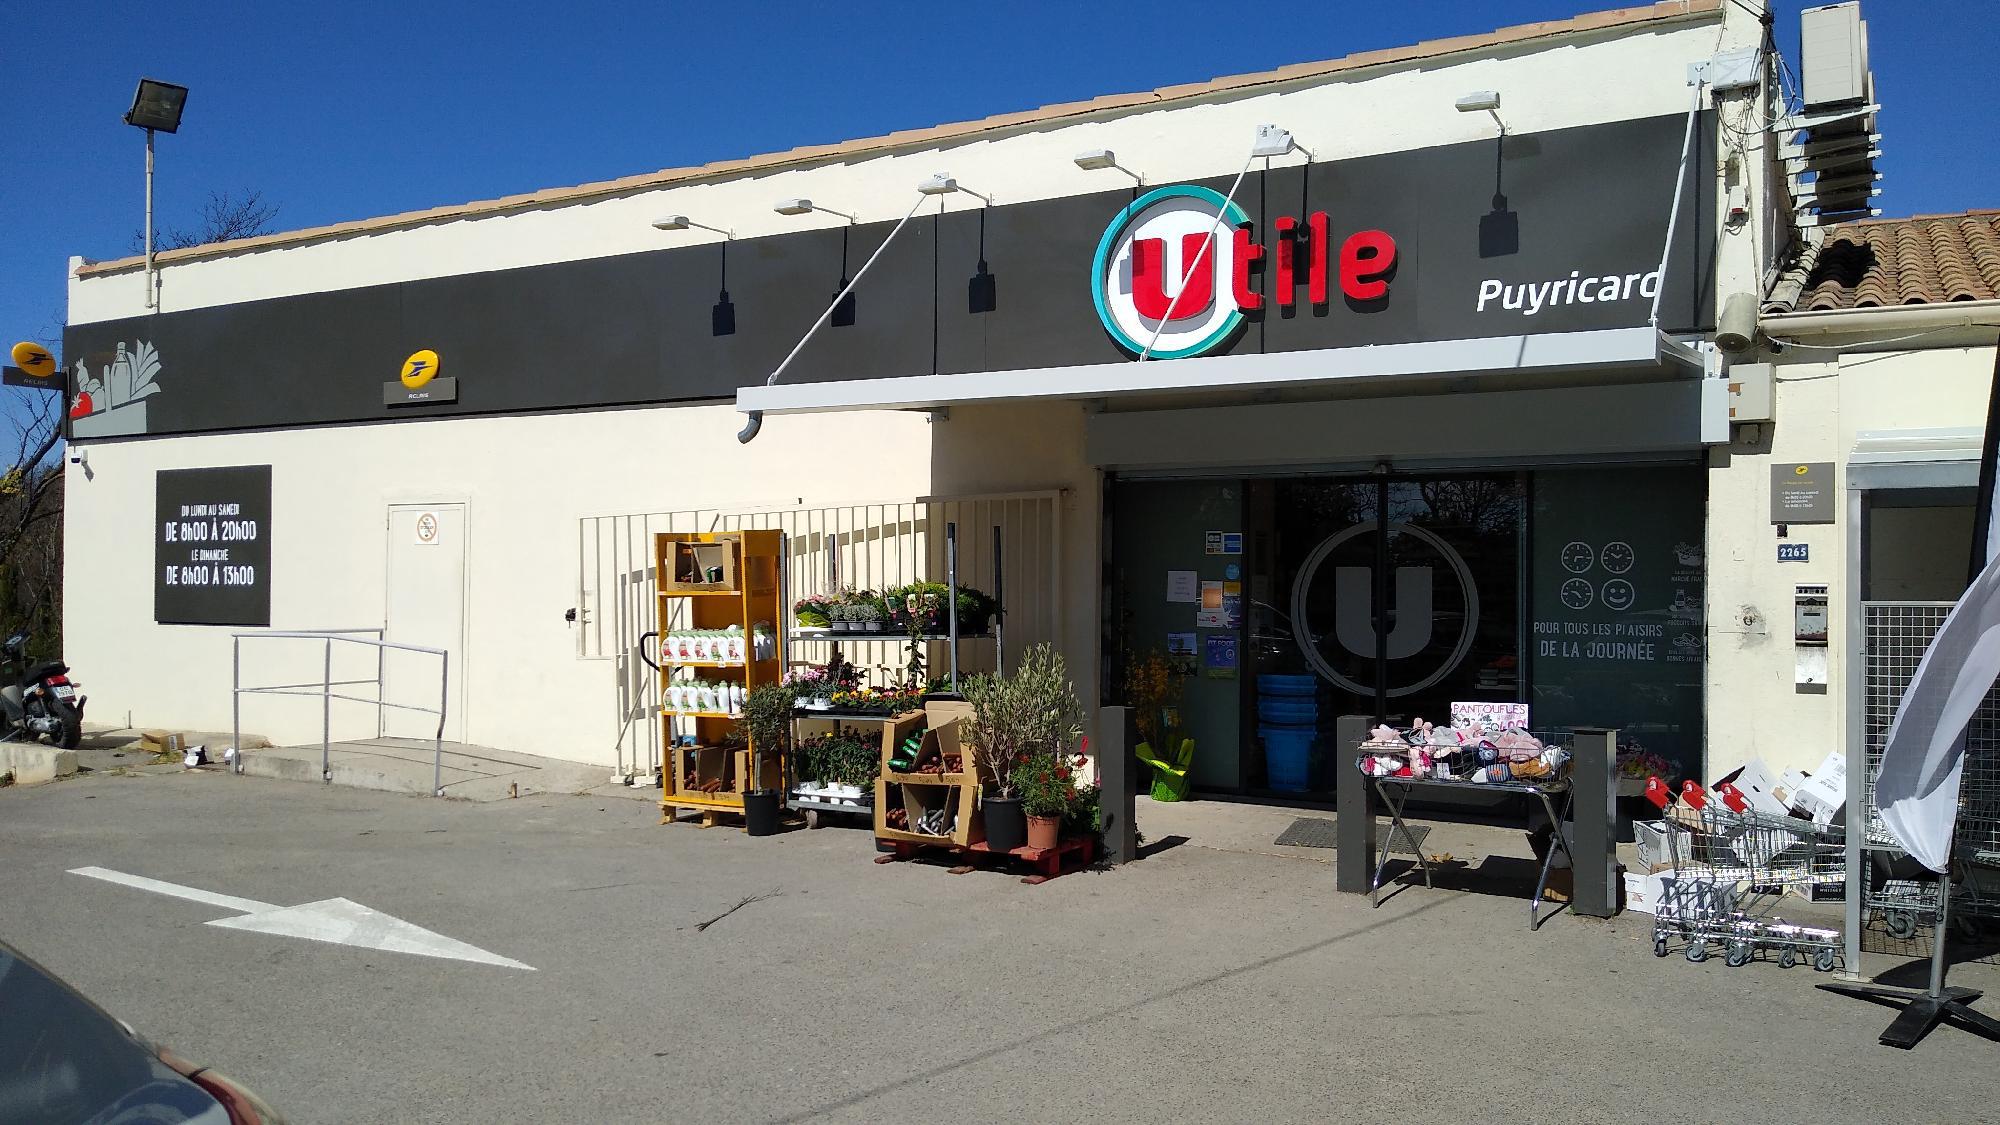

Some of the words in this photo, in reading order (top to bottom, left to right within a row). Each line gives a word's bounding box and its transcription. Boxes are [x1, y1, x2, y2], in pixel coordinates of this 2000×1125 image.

[1476, 264, 1664, 316] Puyricard
[181, 505, 190, 517] DU
[190, 504, 208, 516] LUNDI
[208, 504, 217, 516] AU
[218, 503, 240, 516] SAMEDI
[165, 521, 178, 542] DE
[181, 521, 208, 541] 8h00
[211, 517, 219, 541] À
[221, 520, 257, 541] 20h00
[191, 549, 199, 561] LE
[199, 549, 229, 561] DIMANCHE
[1780, 547, 1807, 558] 2265
[166, 565, 178, 585] DE
[181, 565, 209, 585] 8h00
[212, 561, 220, 585] À
[222, 565, 254, 585] 13h00
[1335, 566, 1433, 660] U
[1533, 621, 1560, 634] POUR
[1564, 622, 1588, 635] TOUS
[1592, 623, 1611, 636] LES
[1615, 624, 1664, 637] PLAISIRS
[1540, 640, 1557, 657] DE
[1562, 641, 1580, 658] LA
[1586, 639, 1655, 661] JOURNÉE
[1453, 703, 1526, 715] PANTOUFLES
